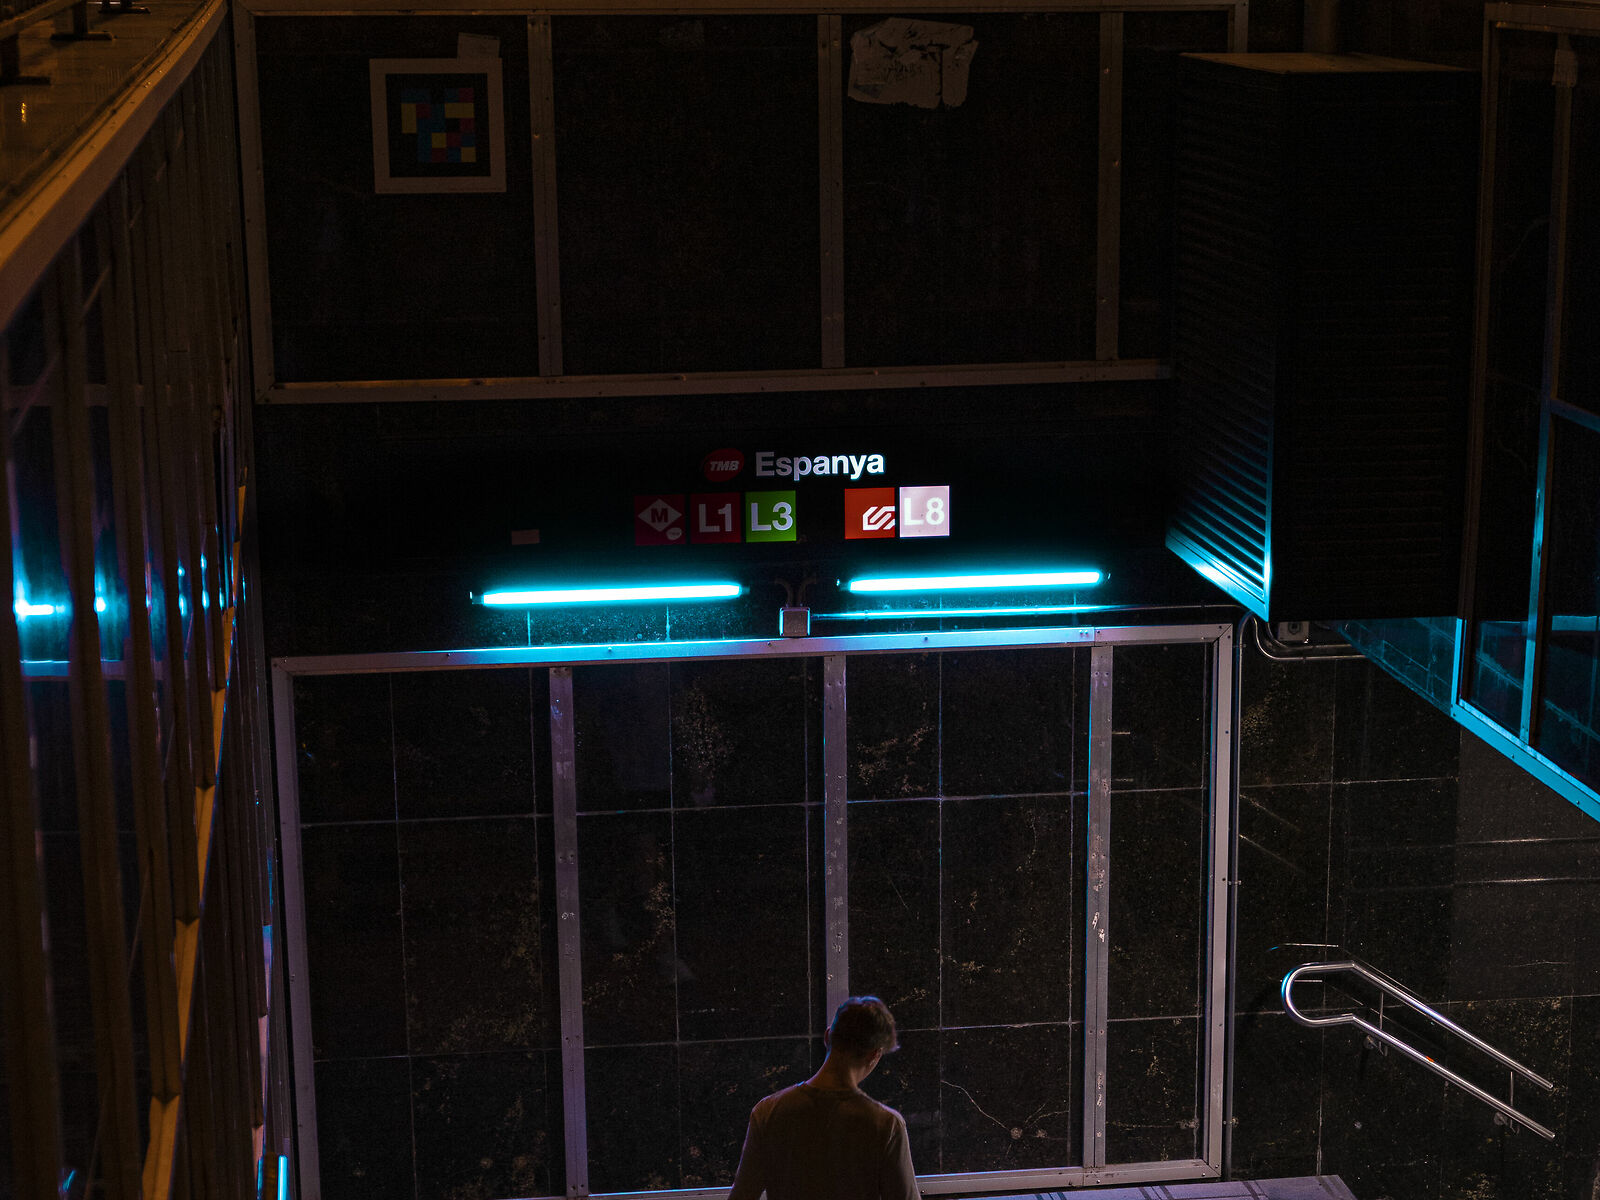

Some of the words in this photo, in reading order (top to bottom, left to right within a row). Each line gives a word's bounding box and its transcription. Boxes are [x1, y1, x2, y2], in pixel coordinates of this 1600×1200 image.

[709, 460, 740, 472] TMB
[755, 451, 885, 482] Espanya
[651, 508, 669, 523] M
[698, 503, 733, 533] L1
[751, 501, 794, 532] L3
[903, 496, 946, 527] L8
